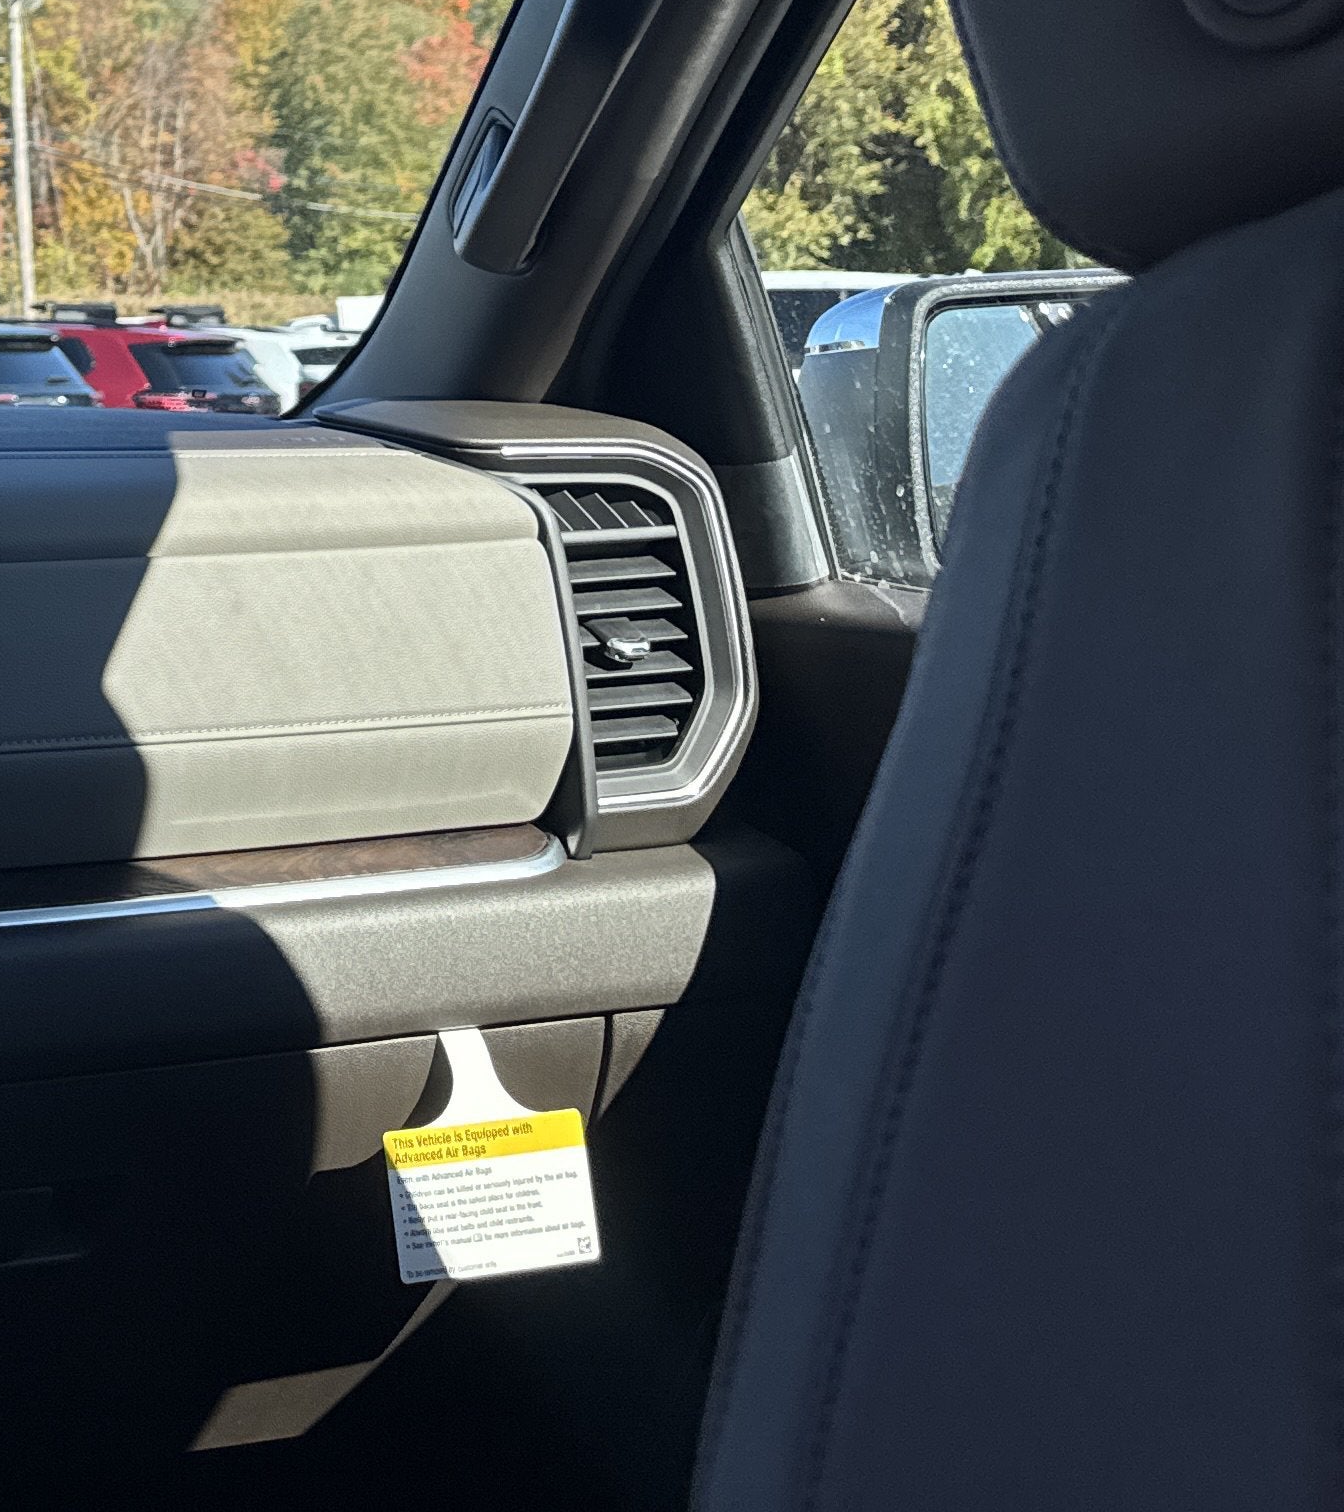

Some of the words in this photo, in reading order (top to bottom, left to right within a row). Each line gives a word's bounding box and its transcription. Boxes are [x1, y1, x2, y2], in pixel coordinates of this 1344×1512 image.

[393, 1136, 414, 1150] This
[416, 1132, 452, 1148] Vehicle
[464, 1124, 509, 1143] Equipped
[511, 1121, 533, 1136] with
[394, 1148, 443, 1165] Advanced
[445, 1146, 459, 1158] Air
[461, 1142, 487, 1159] Bags
